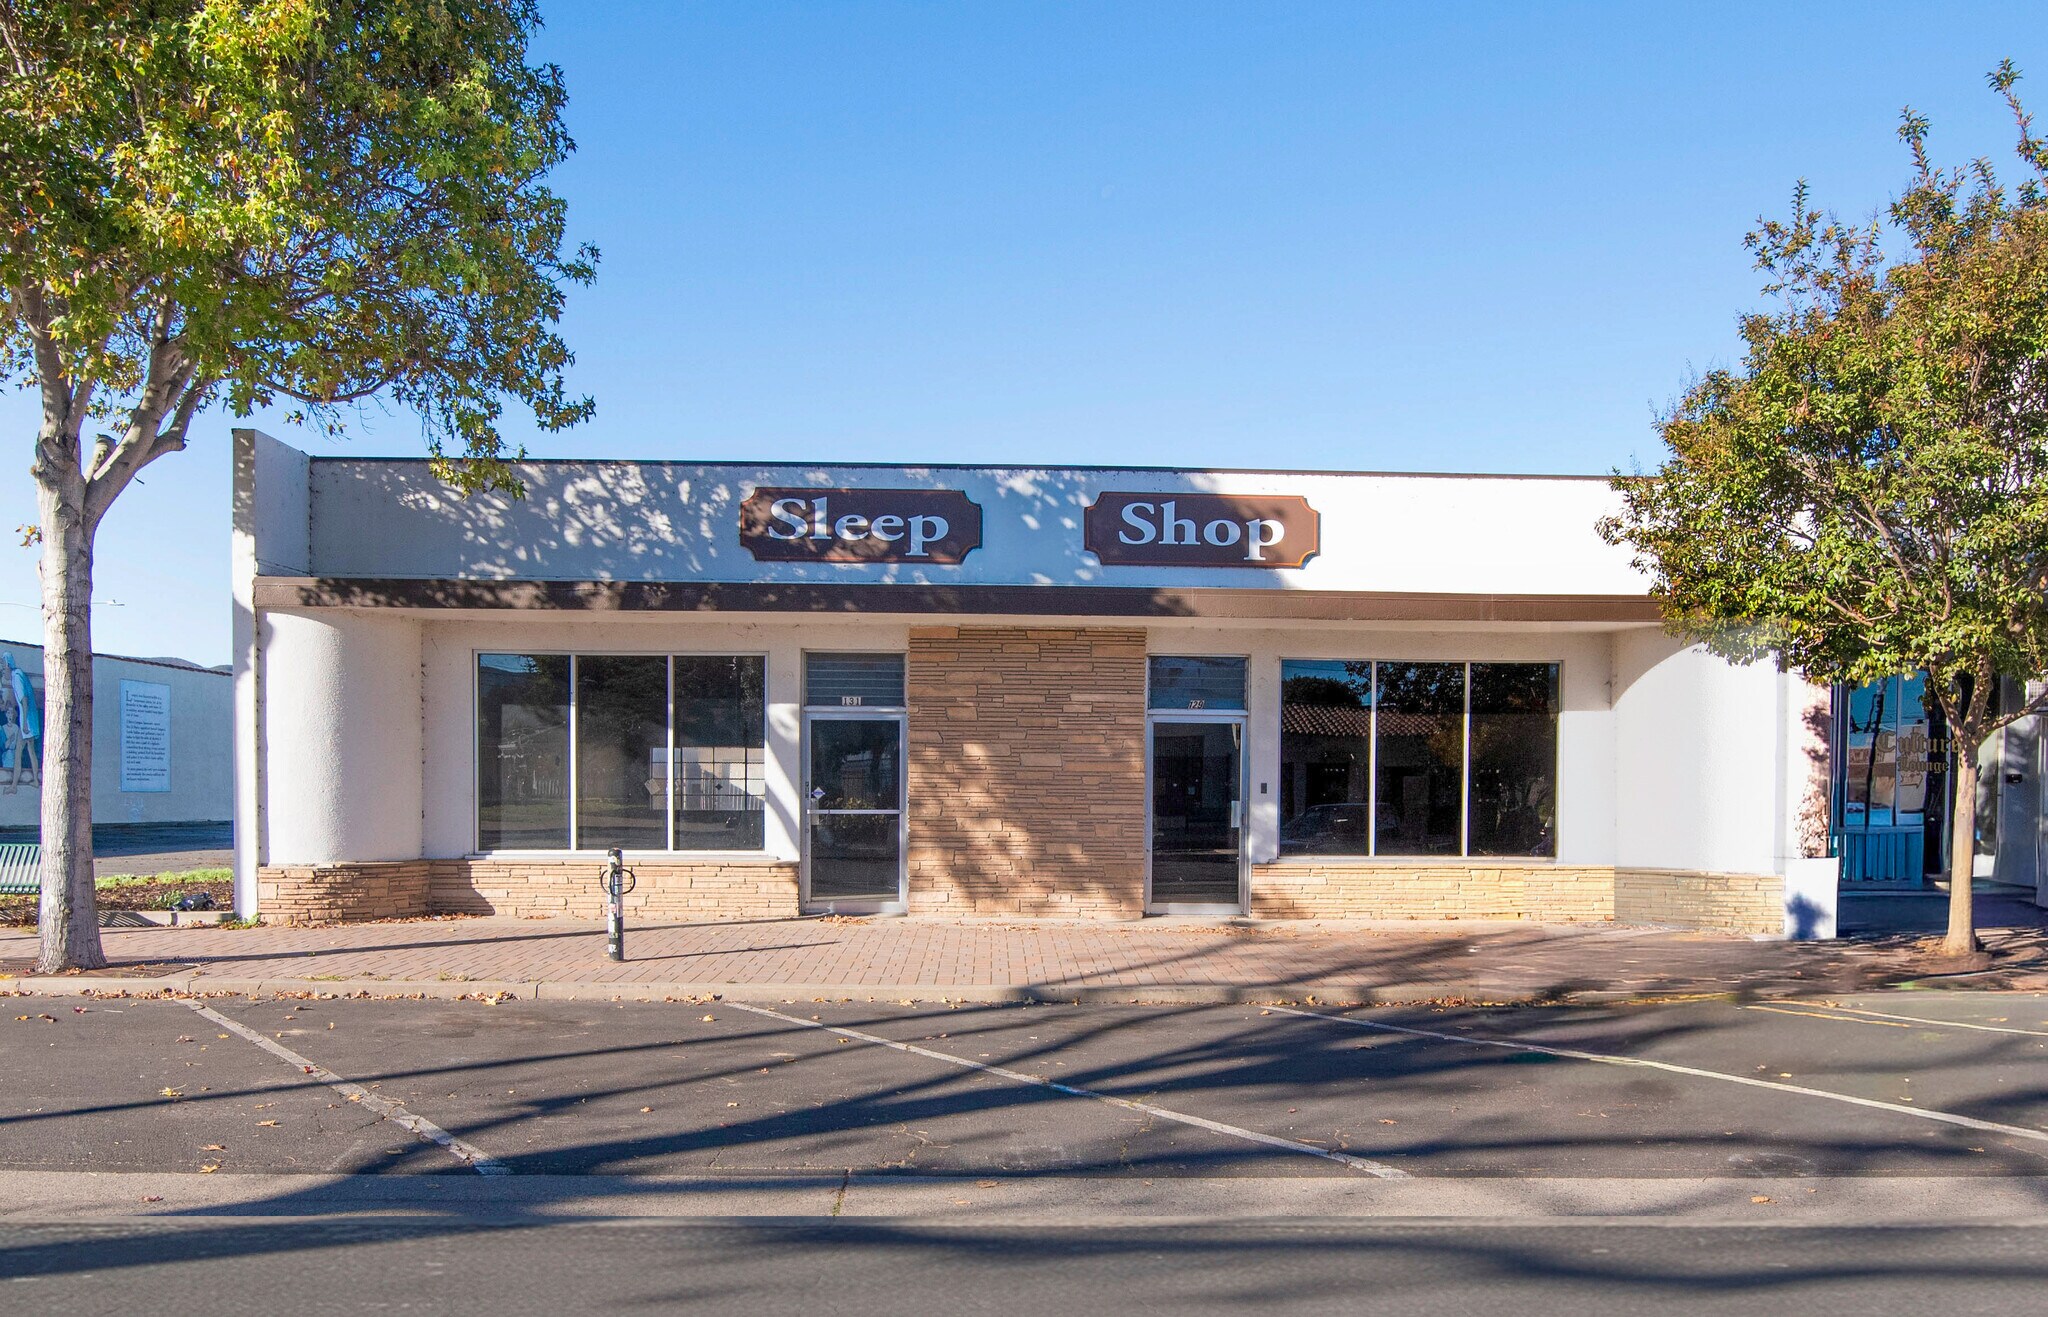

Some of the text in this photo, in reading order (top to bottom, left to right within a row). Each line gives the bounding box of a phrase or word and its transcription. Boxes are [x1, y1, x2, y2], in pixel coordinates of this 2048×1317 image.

[768, 496, 1285, 561] Sleep Shop
[843, 697, 860, 706] 131
[1875, 730, 1959, 754] Culture
[1897, 756, 1950, 773] Lounge
